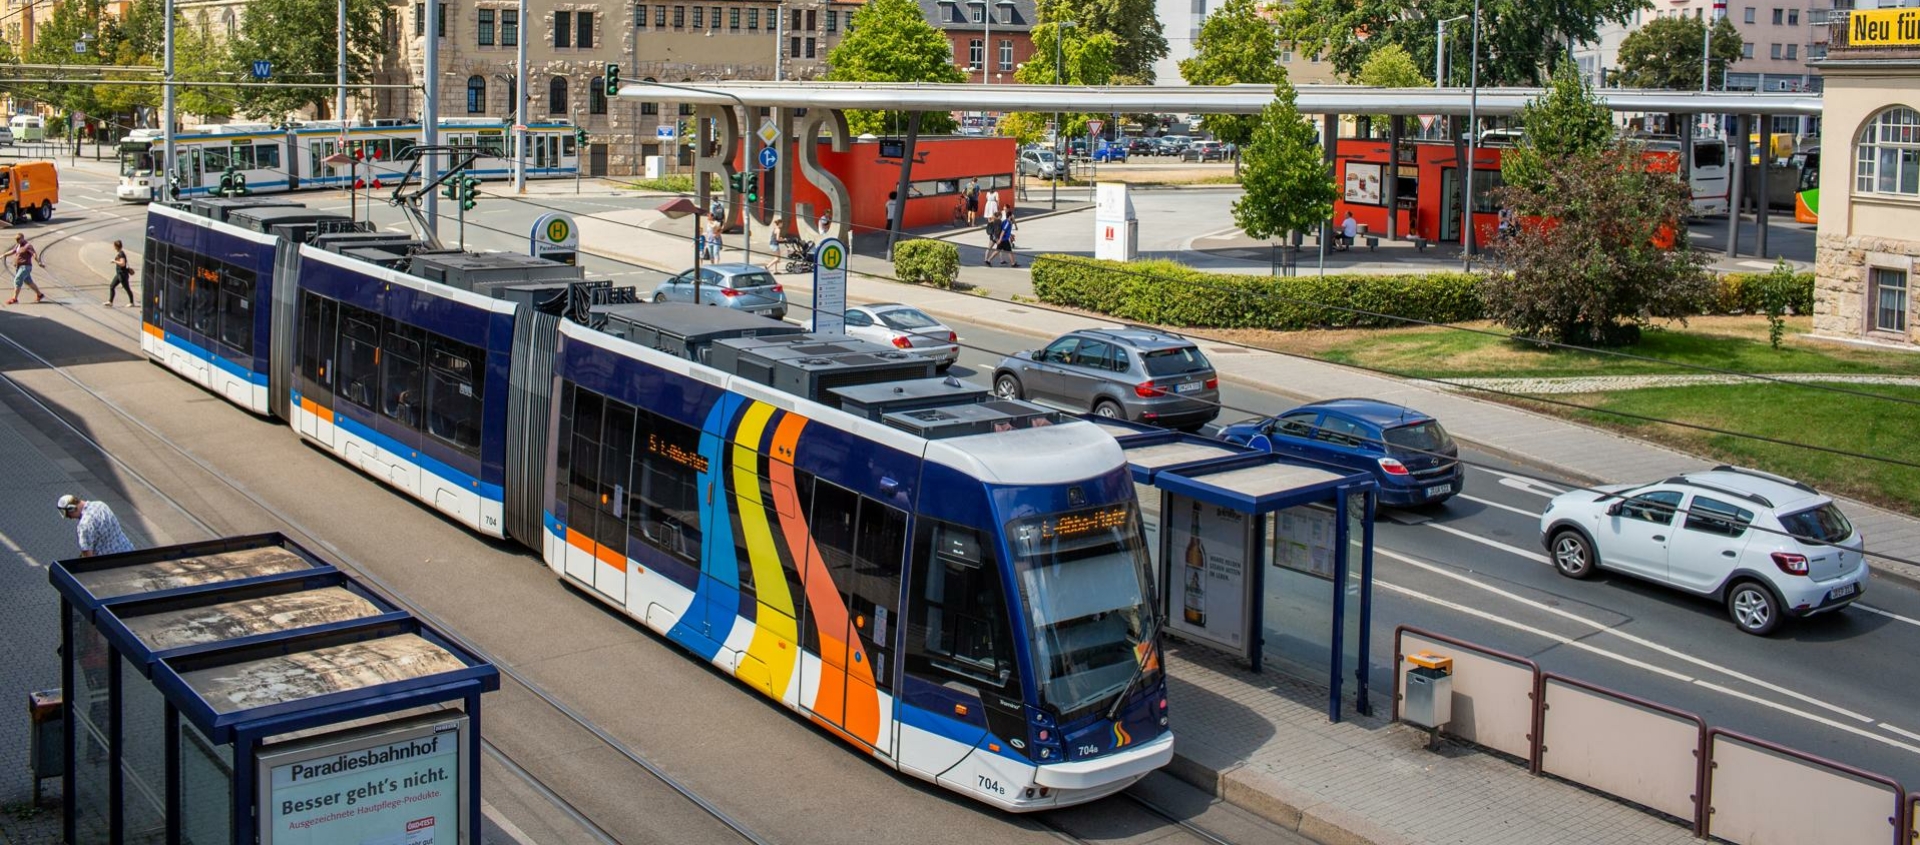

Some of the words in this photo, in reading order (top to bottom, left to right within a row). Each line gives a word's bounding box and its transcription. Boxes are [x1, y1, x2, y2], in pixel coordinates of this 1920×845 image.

[1855, 14, 1890, 41] Neu
[1898, 12, 1920, 40] fü
[254, 62, 270, 75] W
[694, 103, 851, 245] BUS
[485, 515, 497, 527] 704
[291, 737, 438, 782] Paradiesbahnhof
[282, 792, 341, 815] Besser
[403, 766, 449, 789] nicht.
[289, 809, 354, 830] Ausgezeichnete
[357, 789, 442, 815] Hautpflege-Produkte.
